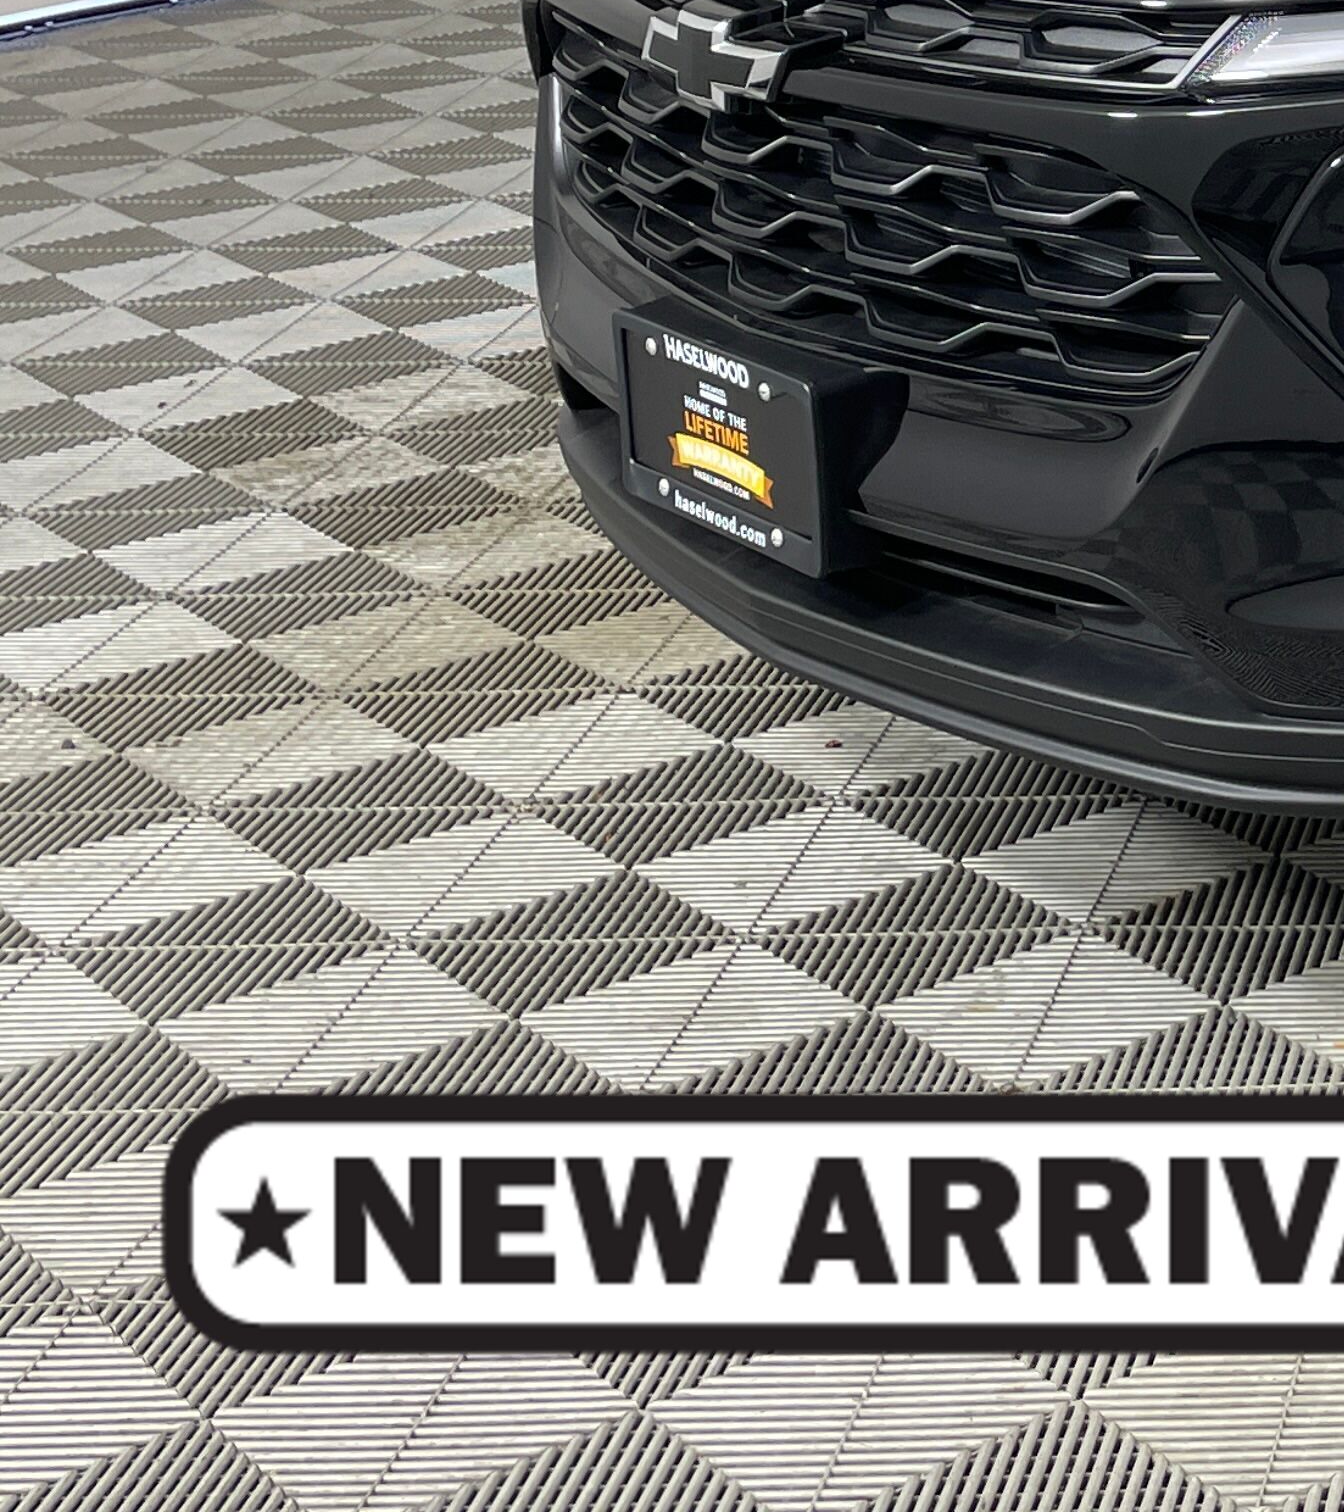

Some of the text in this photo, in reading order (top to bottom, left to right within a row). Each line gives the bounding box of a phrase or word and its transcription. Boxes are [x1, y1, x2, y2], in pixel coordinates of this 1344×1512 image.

[663, 334, 749, 388] HASELWOOD
[684, 394, 747, 432] HOME OF THE
[684, 410, 749, 456] LIFETIME
[674, 489, 766, 548] haselwood.com
